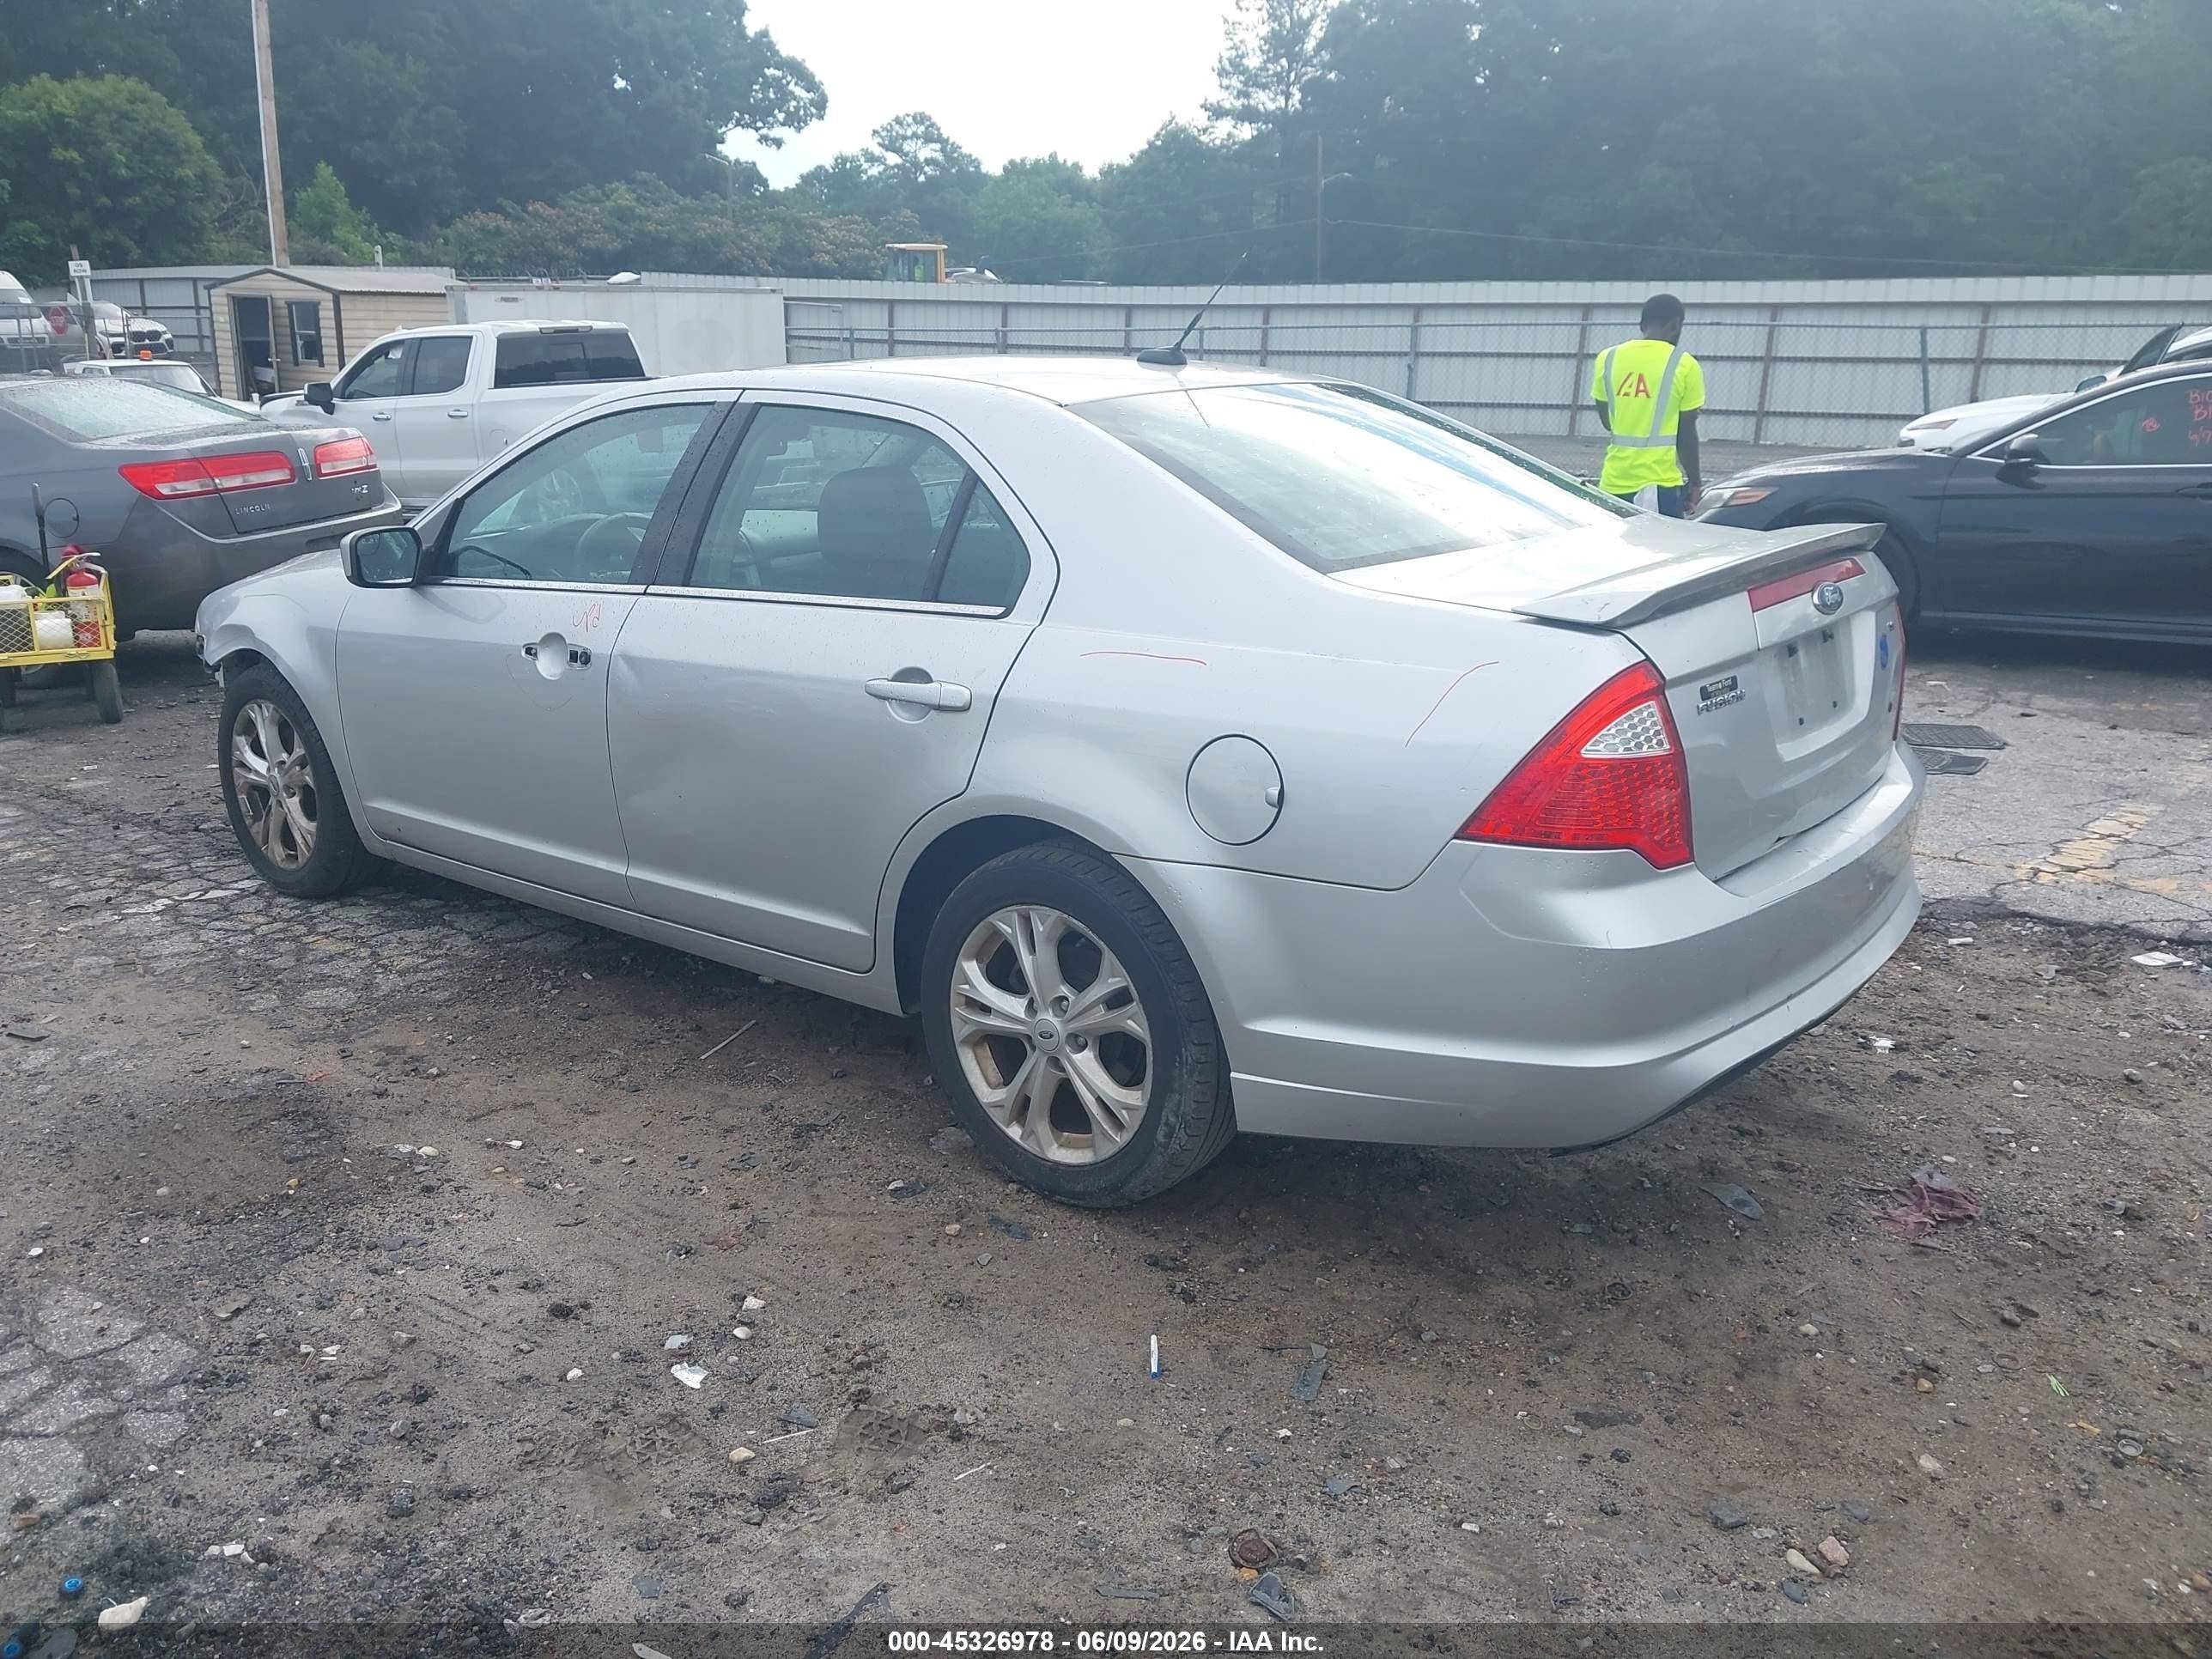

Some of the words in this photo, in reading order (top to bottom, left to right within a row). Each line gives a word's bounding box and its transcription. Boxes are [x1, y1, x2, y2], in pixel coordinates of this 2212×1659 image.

[235, 503, 270, 514] LINCOLN
[1822, 586, 1842, 605] Ford
[1697, 689, 1746, 714] FUSION
